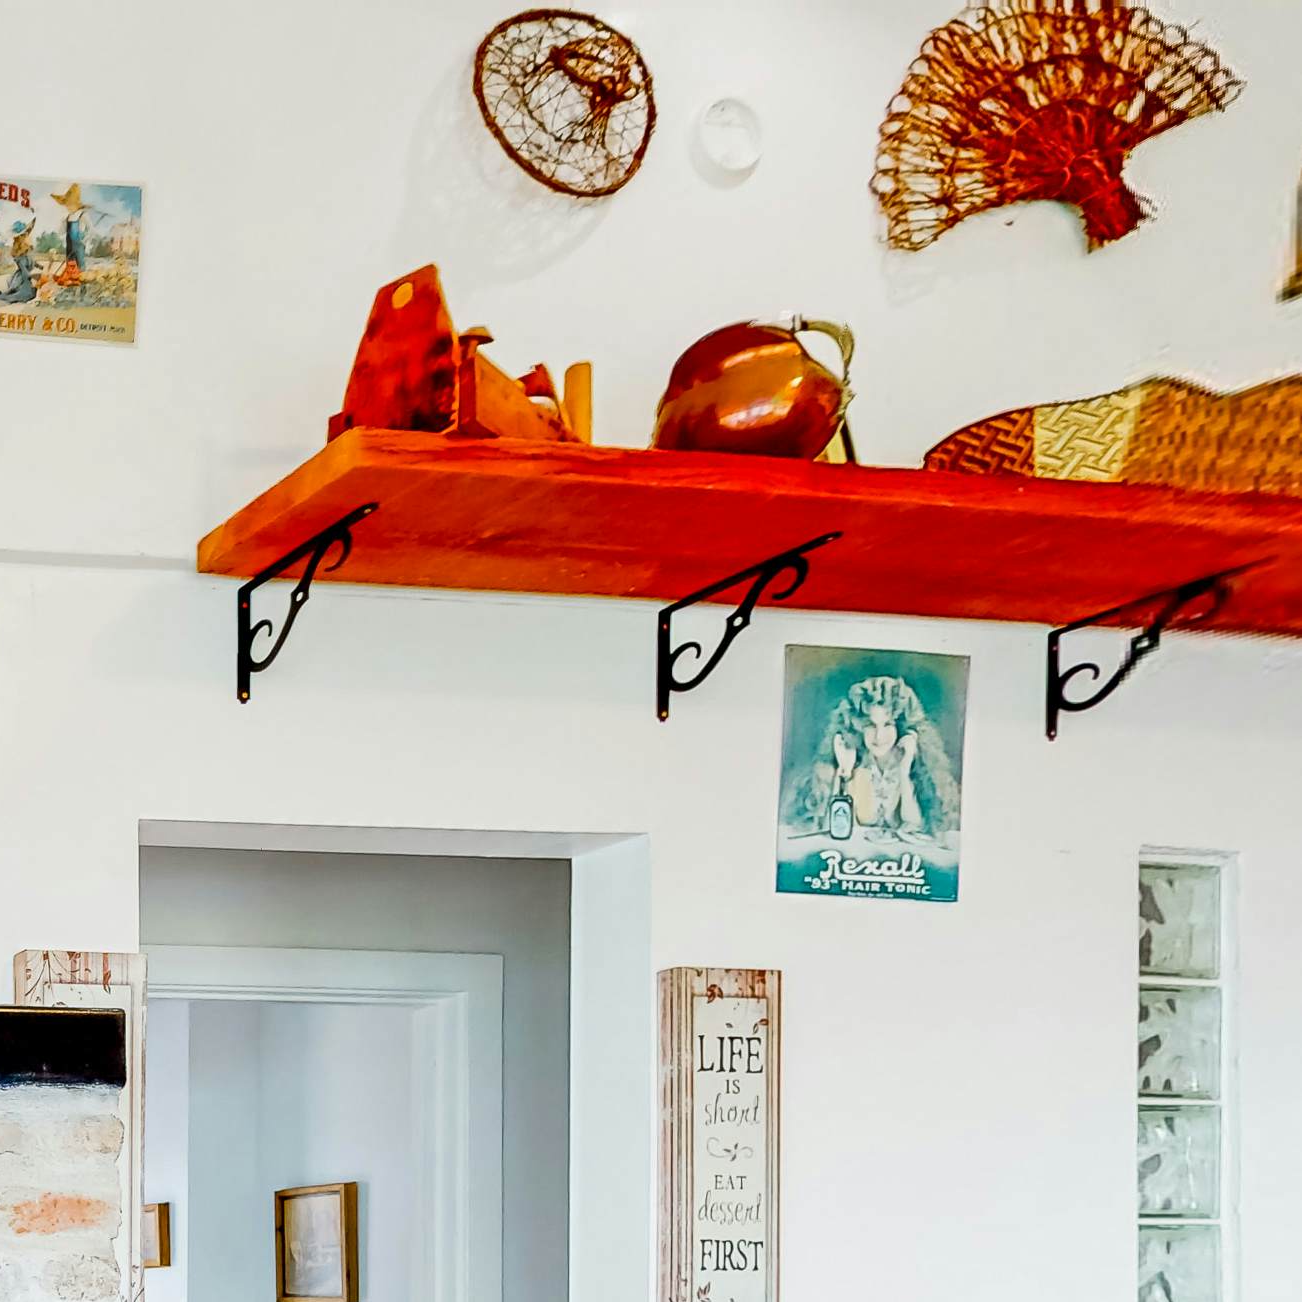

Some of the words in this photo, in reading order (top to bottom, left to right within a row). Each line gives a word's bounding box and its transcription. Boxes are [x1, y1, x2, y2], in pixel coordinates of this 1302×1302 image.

[42, 317, 53, 332] &
[819, 850, 925, 883] Rexall
[841, 880, 880, 892] HAIR
[885, 883, 932, 895] TONIC
[697, 1035, 764, 1074] LIFE
[726, 1079, 741, 1094] IS
[704, 1092, 761, 1126] short
[714, 1174, 747, 1190] EAT
[698, 1190, 762, 1225] dessert
[700, 1239, 764, 1271] FIRST
